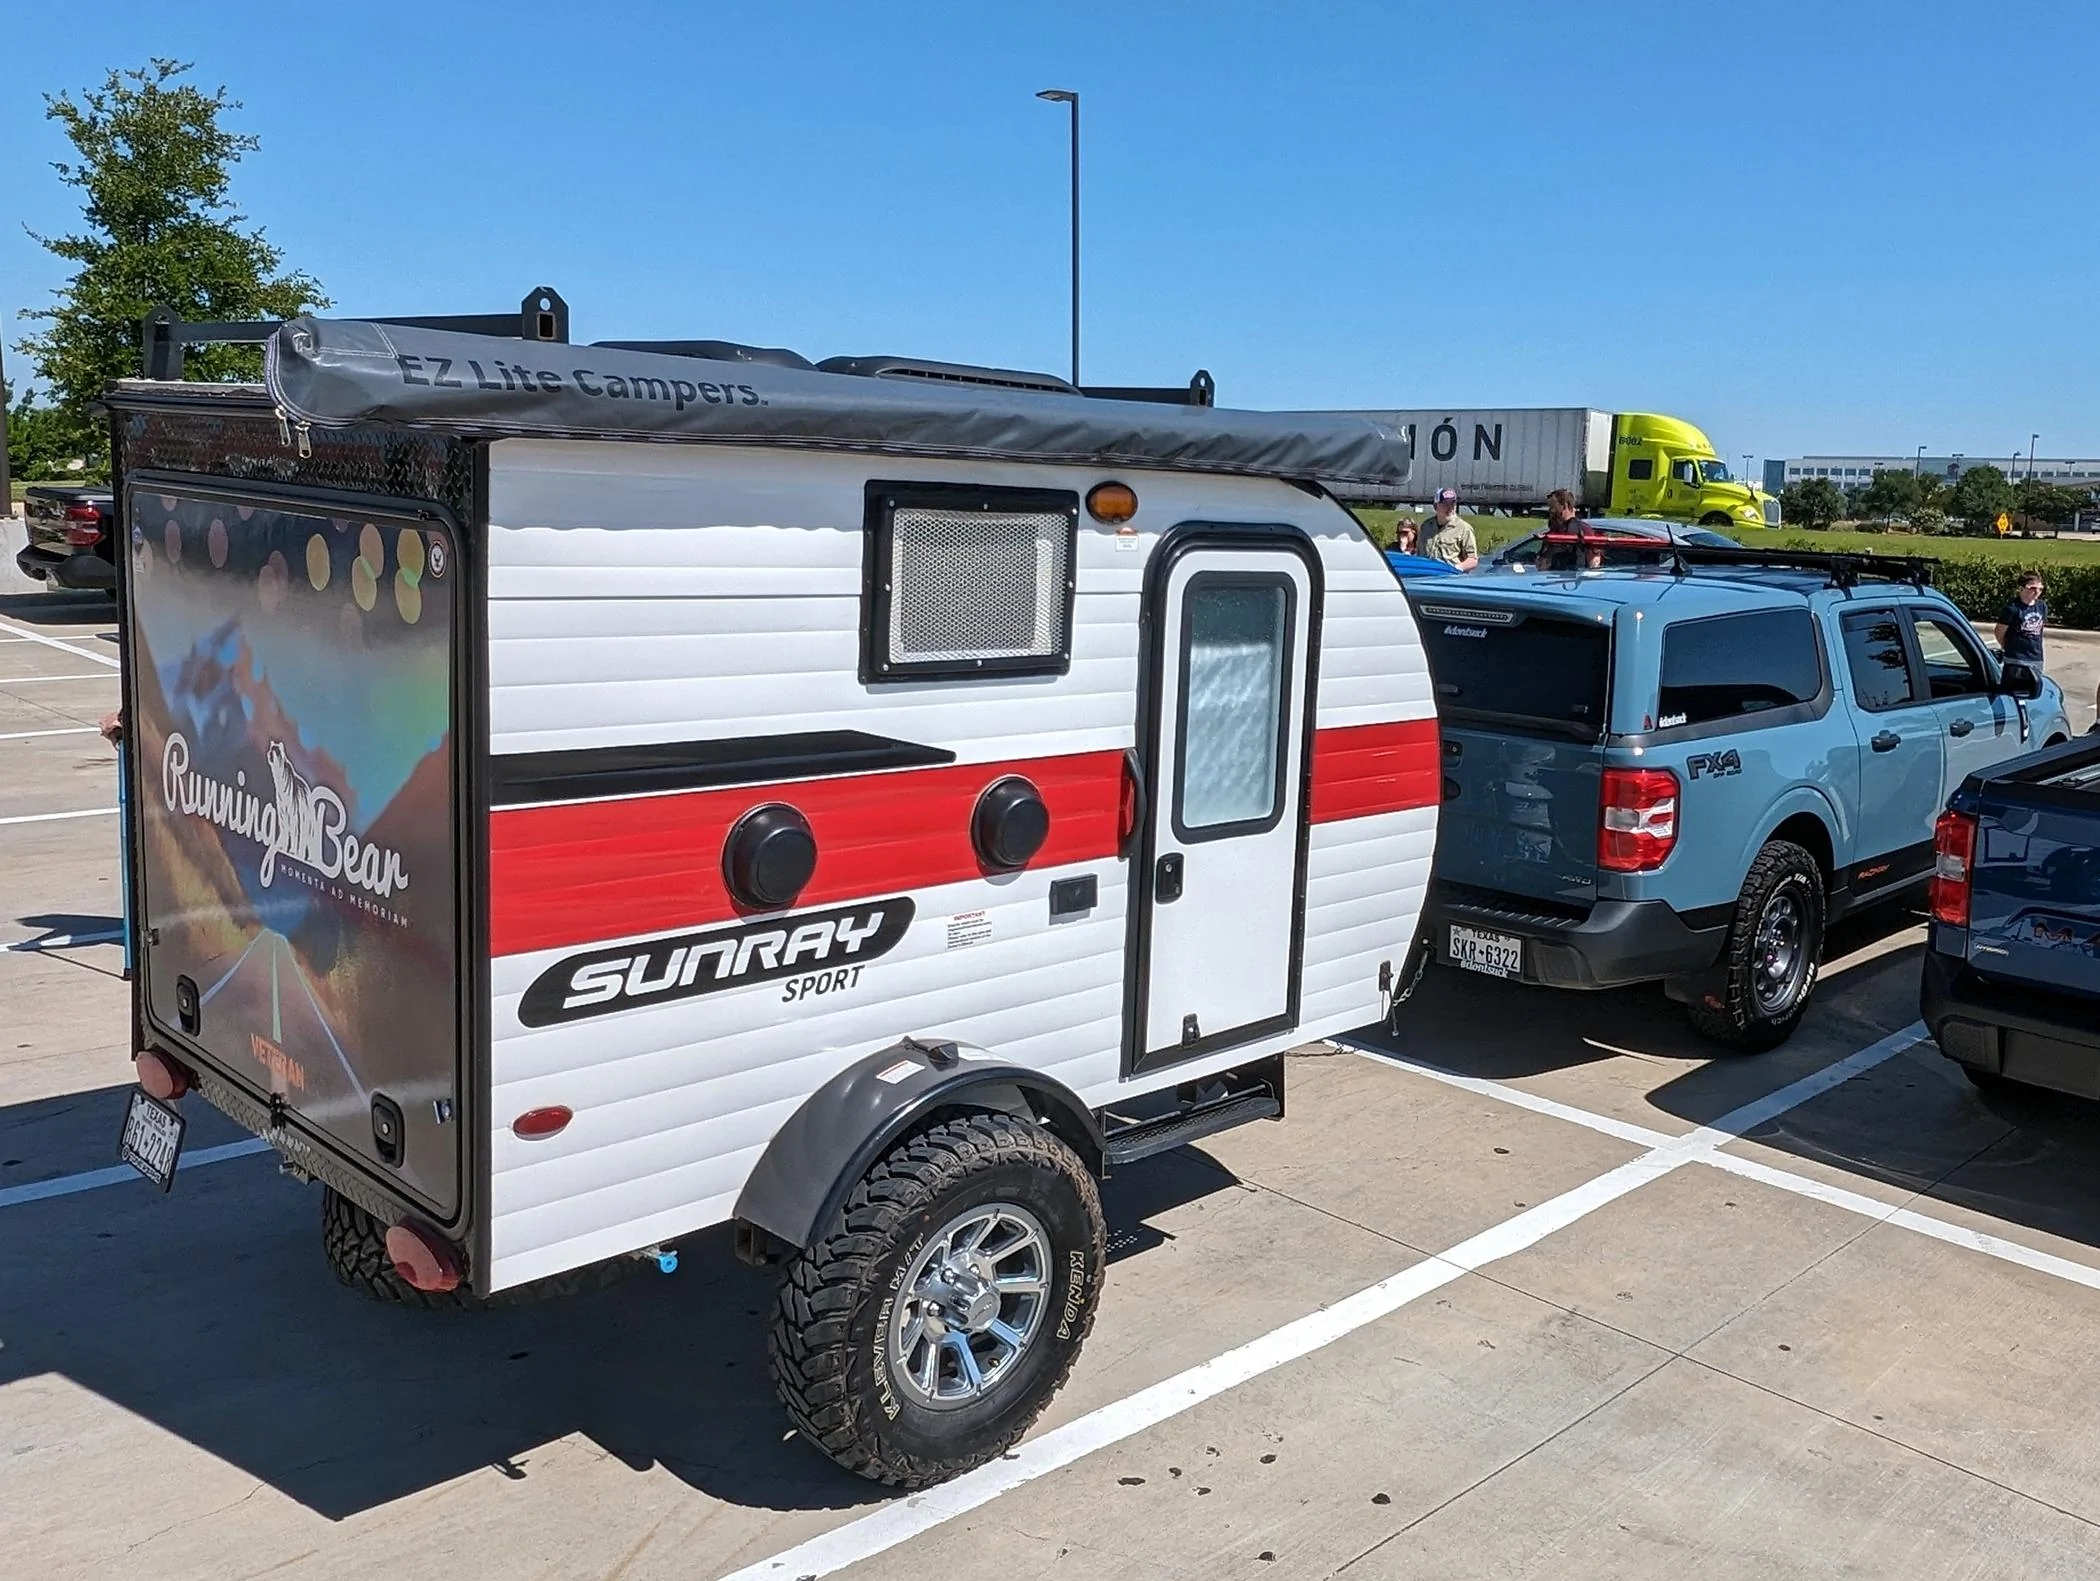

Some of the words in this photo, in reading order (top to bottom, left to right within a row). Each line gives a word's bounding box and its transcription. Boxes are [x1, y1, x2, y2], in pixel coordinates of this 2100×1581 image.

[397, 353, 463, 388] EZ
[467, 360, 562, 393] Lite
[1687, 748, 1741, 781] FX4
[162, 732, 280, 888] Running
[309, 785, 409, 898] Bear
[1472, 927, 1500, 943] TEXAS
[562, 911, 885, 1010] SUNRAY
[782, 965, 865, 1003] SPORT
[146, 1103, 168, 1129] TEXAS
[1056, 1250, 1085, 1340] KENDA
